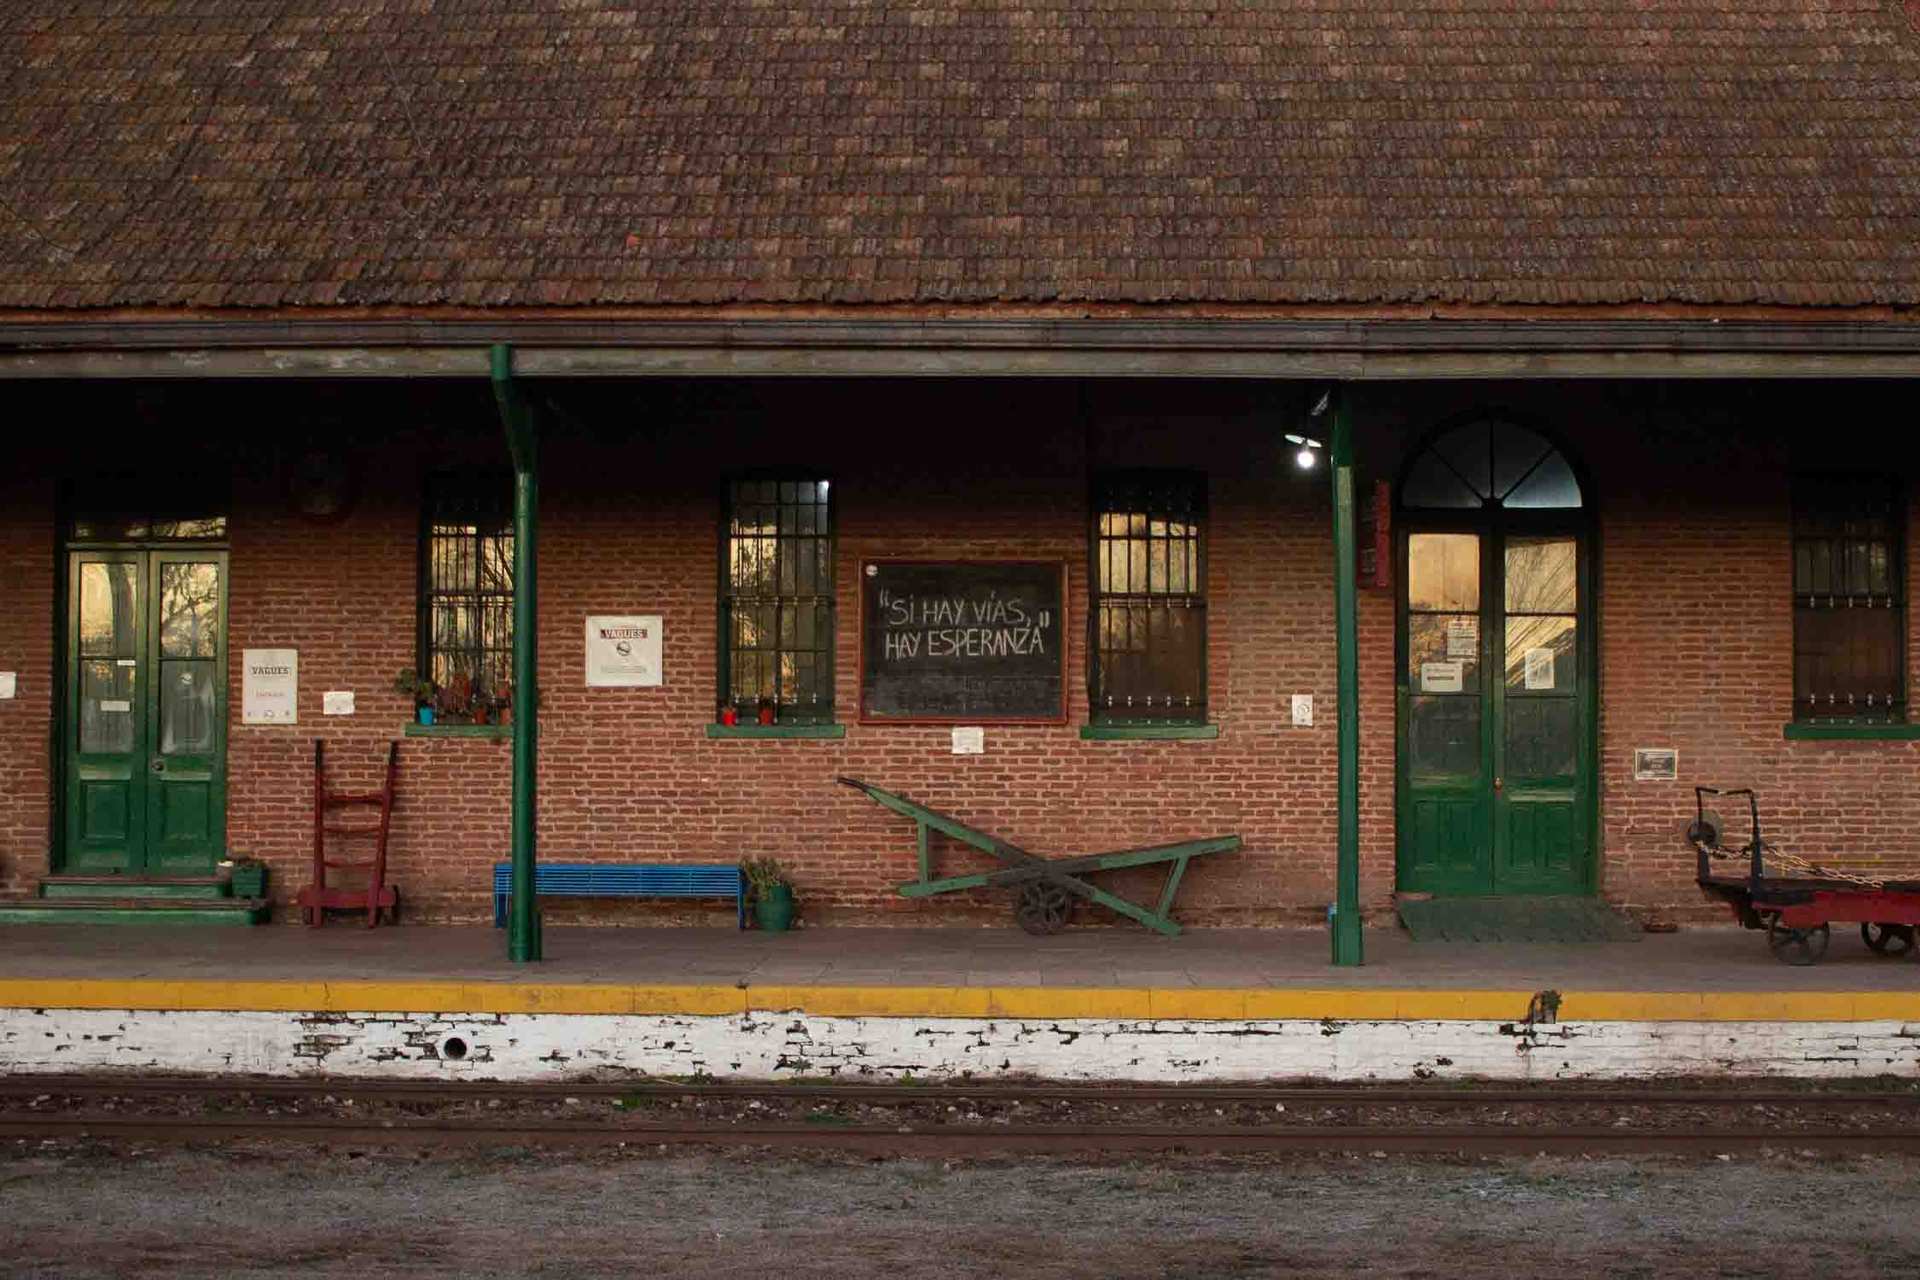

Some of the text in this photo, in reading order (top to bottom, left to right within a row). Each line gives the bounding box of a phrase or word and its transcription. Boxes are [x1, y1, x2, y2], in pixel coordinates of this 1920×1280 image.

[922, 599, 966, 626] HAY
[604, 629, 644, 639] VAGUES
[885, 631, 922, 661] HAY
[252, 666, 289, 675] VAGUES
